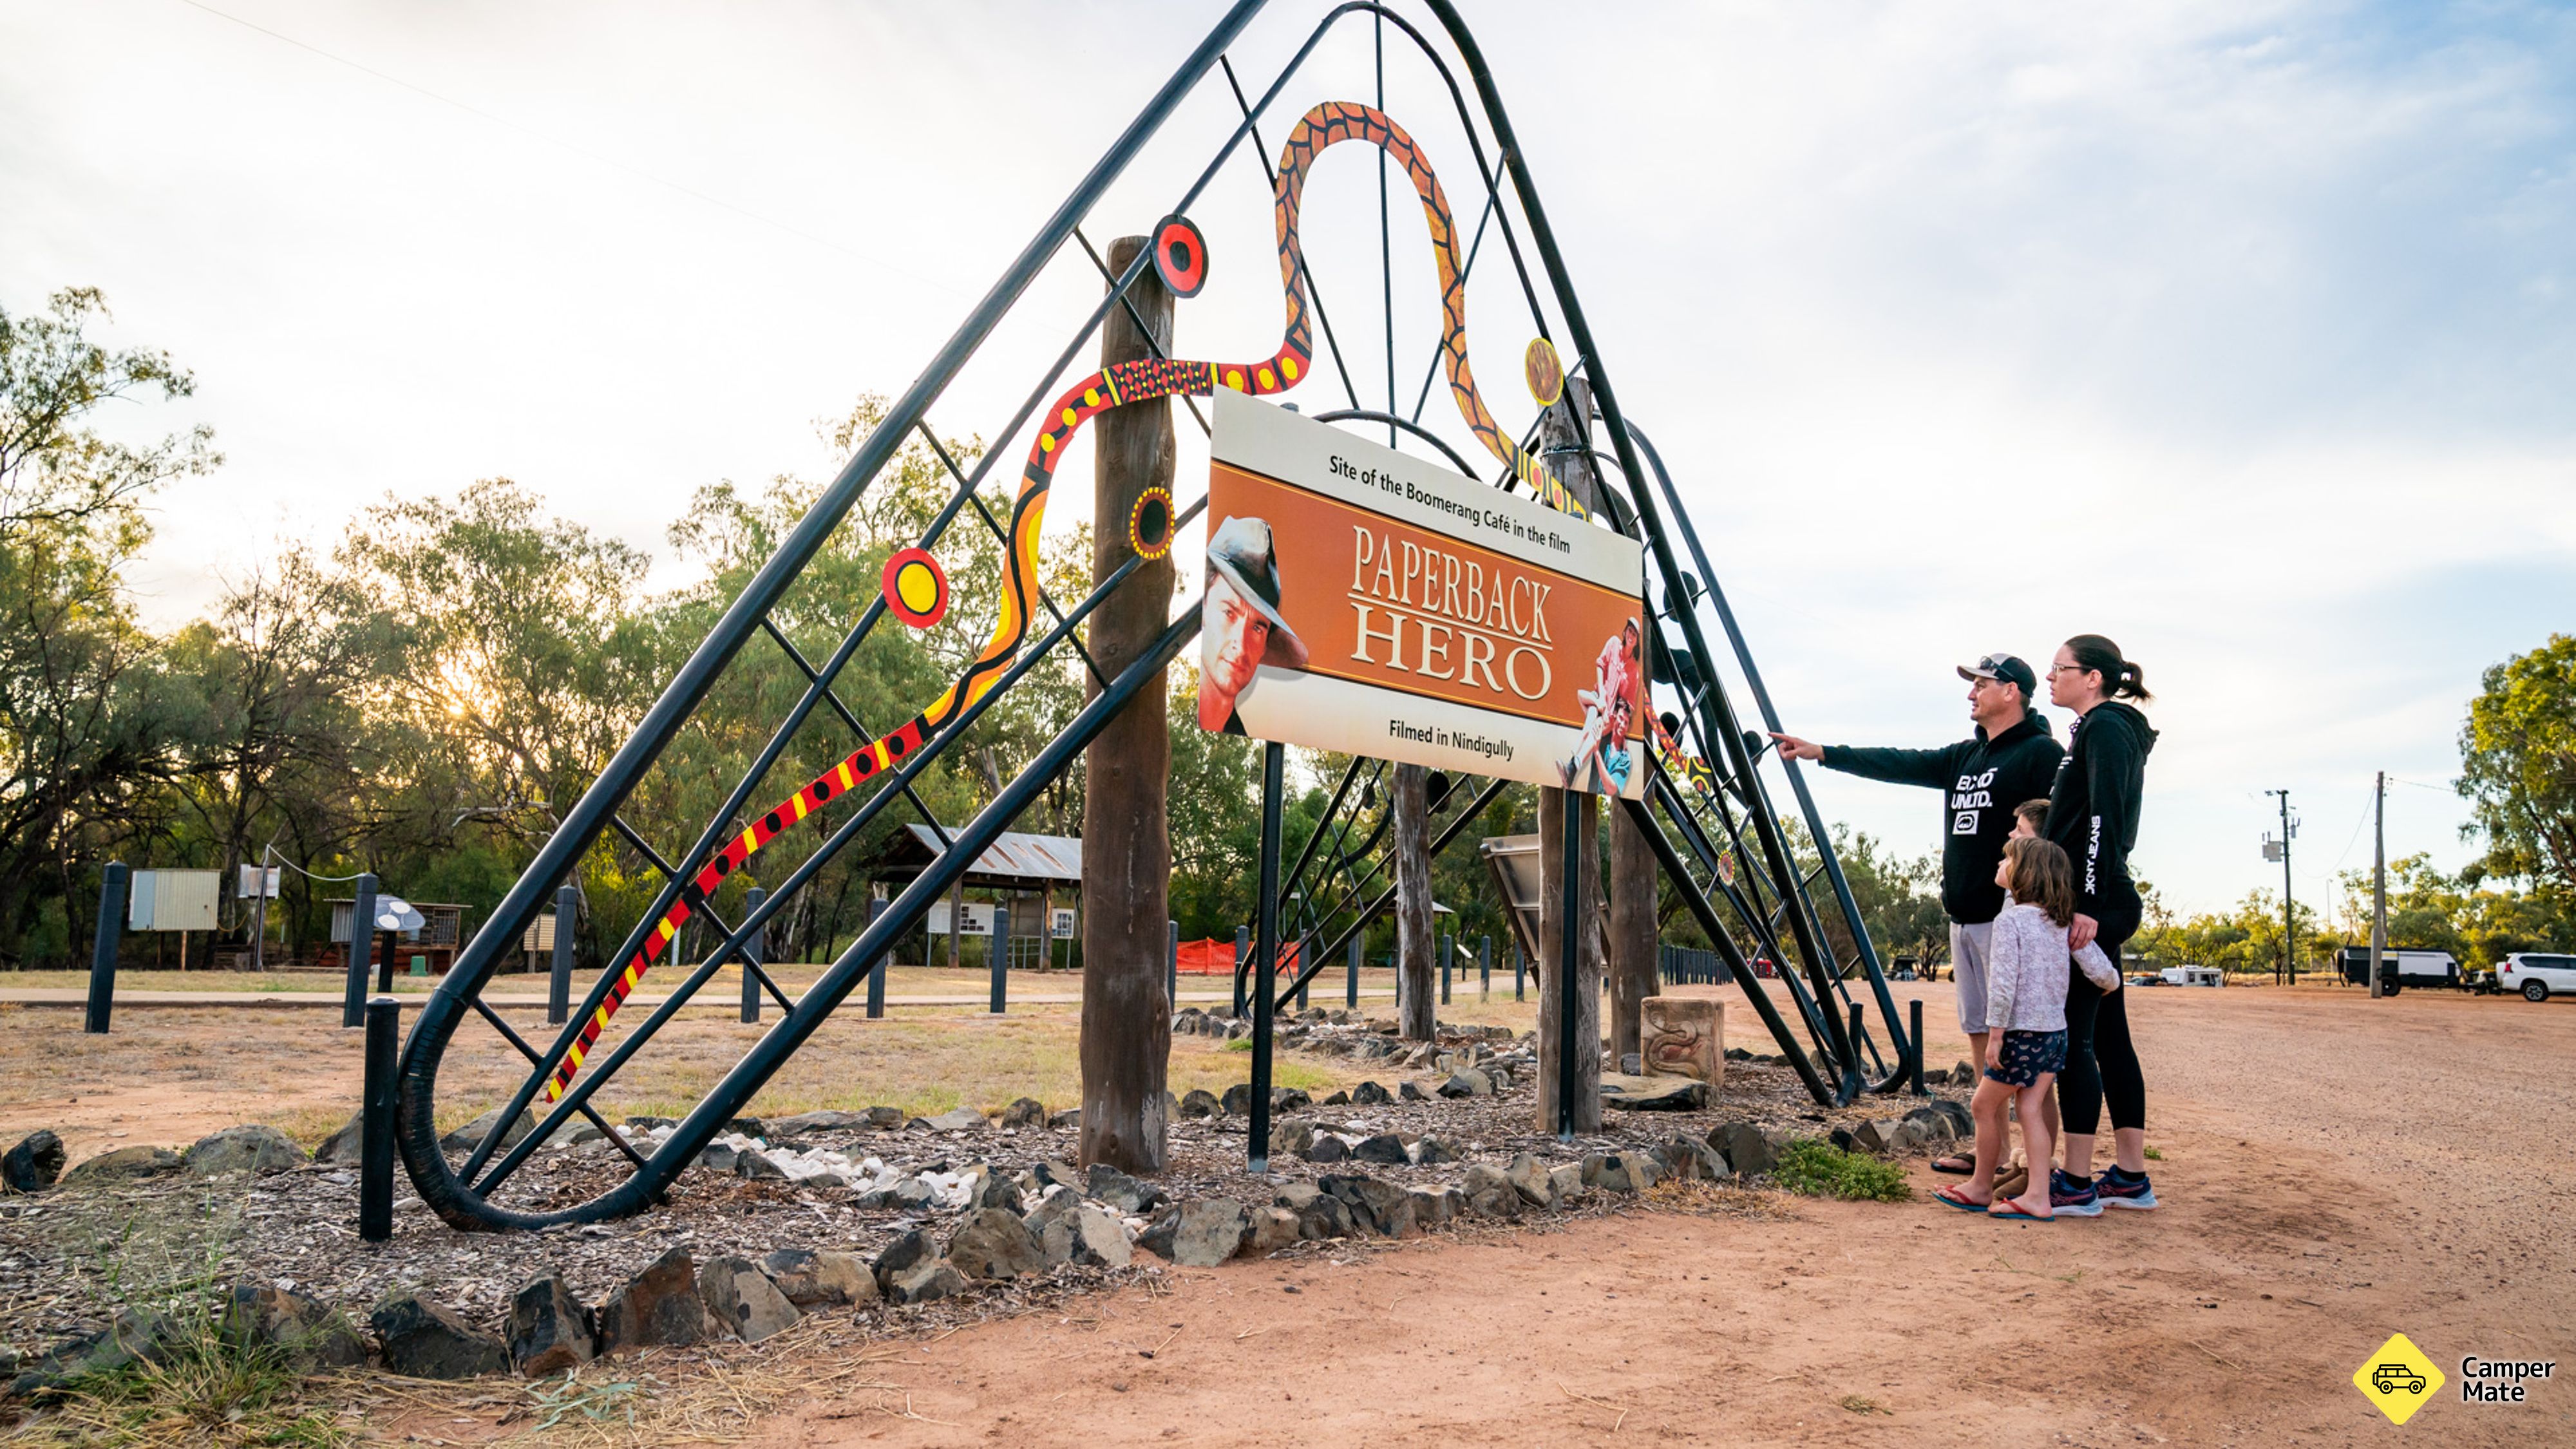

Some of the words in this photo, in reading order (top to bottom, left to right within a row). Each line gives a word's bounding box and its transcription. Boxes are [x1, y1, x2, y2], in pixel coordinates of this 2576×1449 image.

[1330, 455, 1357, 480] Site
[1361, 469, 1377, 486] of
[1380, 474, 1402, 495] the
[1407, 482, 1479, 527] Boomerang
[1484, 511, 1510, 533] Café
[1513, 520, 1524, 538] in
[1528, 526, 1546, 545] the
[1549, 532, 1570, 554] film
[1352, 525, 1552, 643] PAPERBACK
[1350, 601, 1551, 701] HERO
[1390, 719, 1433, 744] Filmed
[1437, 728, 1448, 746] in
[1453, 731, 1514, 762] Nindigully
[1951, 790, 1993, 810] UNLTD.
[2088, 815, 2101, 858] JEANS
